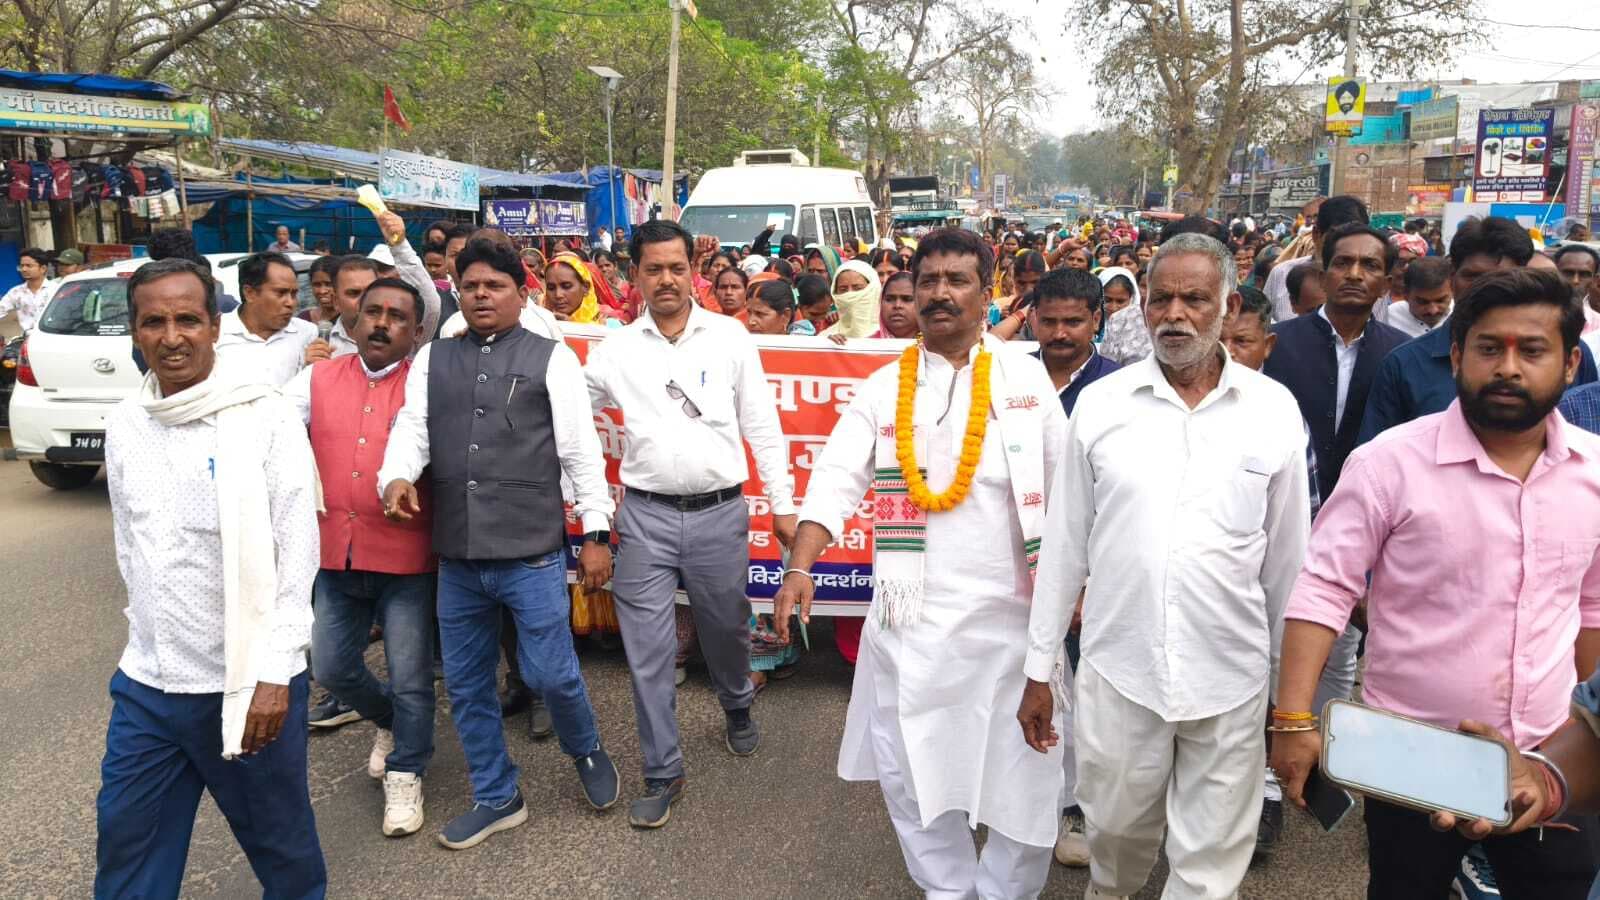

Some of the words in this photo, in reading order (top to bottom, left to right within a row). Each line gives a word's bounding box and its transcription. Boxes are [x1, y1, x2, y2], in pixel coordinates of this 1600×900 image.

[37, 98, 99, 116] लक्ष्मी
[498, 206, 527, 217] Amul
[748, 565, 784, 585] विरो
